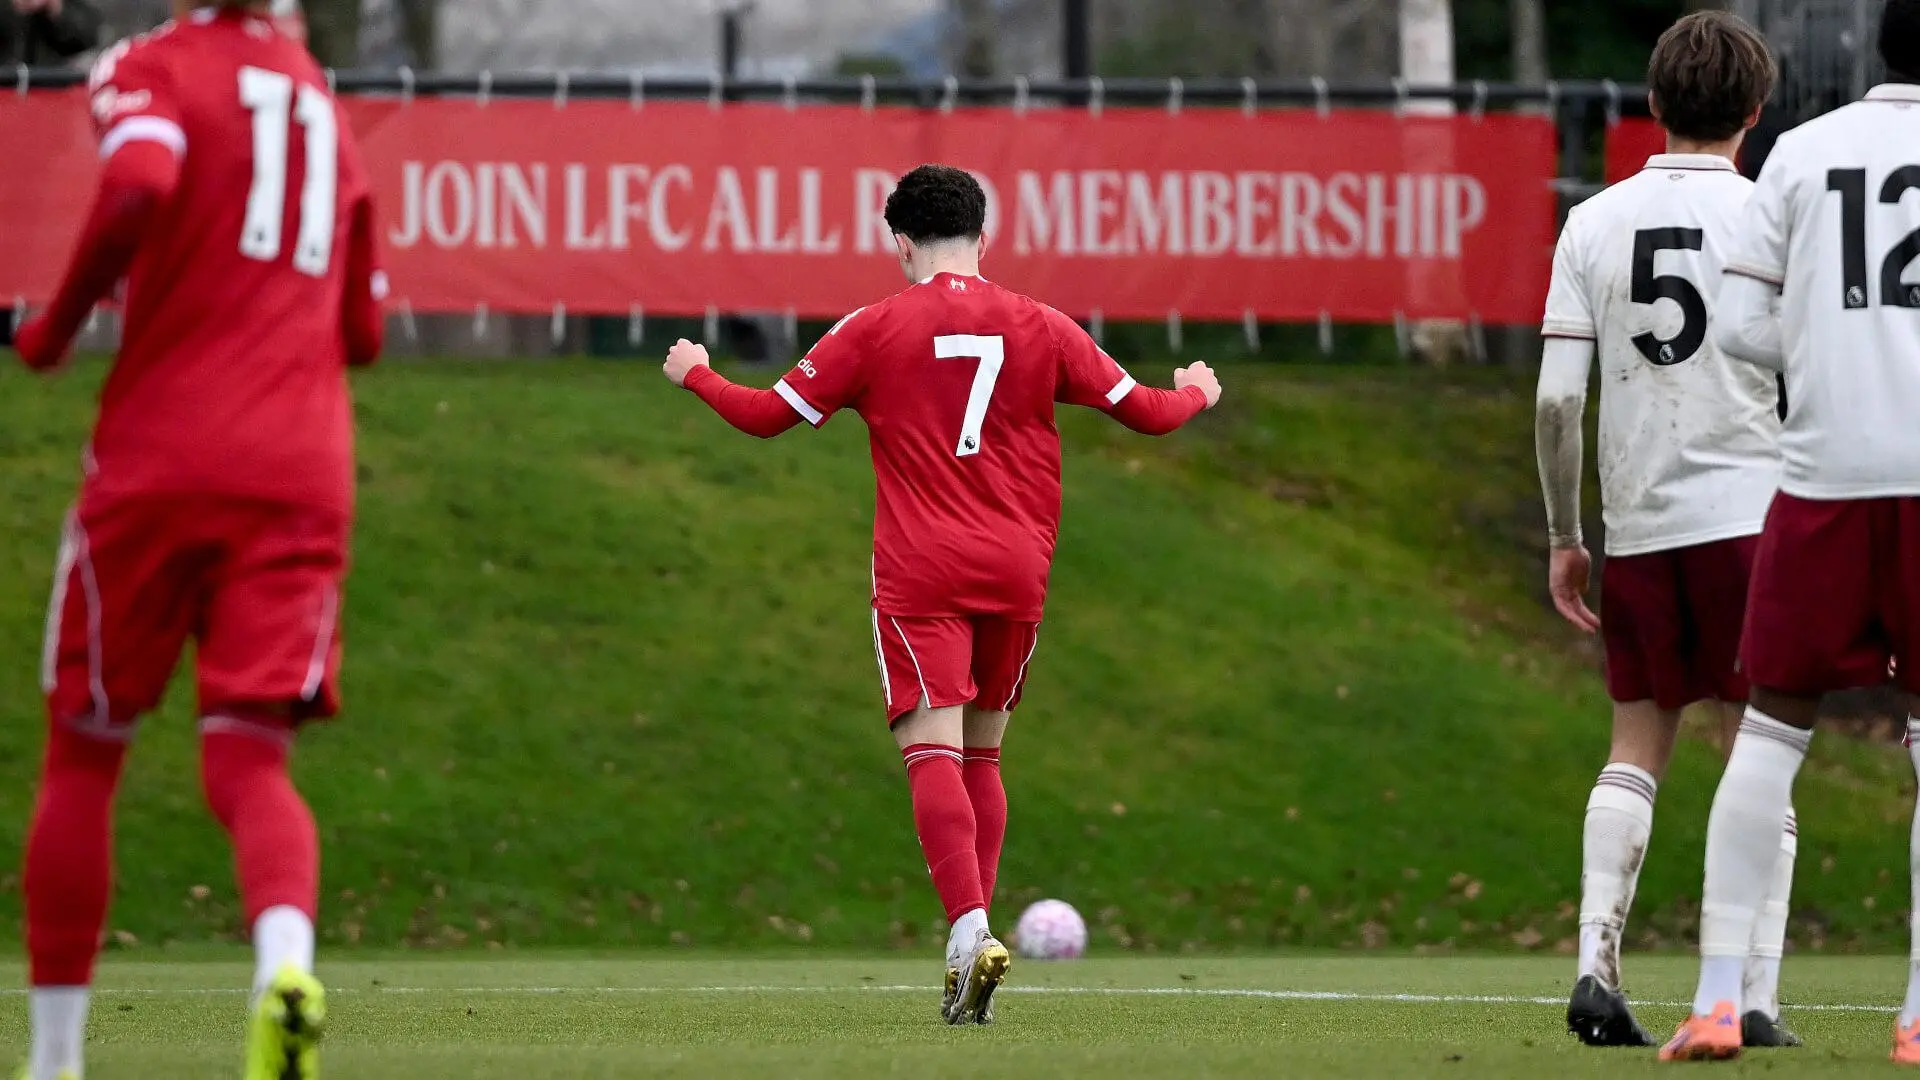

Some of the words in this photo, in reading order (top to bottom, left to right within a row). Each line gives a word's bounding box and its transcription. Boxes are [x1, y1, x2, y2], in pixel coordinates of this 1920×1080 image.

[237, 64, 338, 278] 11
[390, 160, 547, 248] JOIN
[564, 163, 692, 253] LFC
[702, 165, 841, 254] ALL
[1014, 169, 1487, 260] MEMBERSHIP
[1826, 164, 1920, 310] 12
[1629, 226, 1707, 366] 5
[934, 334, 1005, 457] 7
